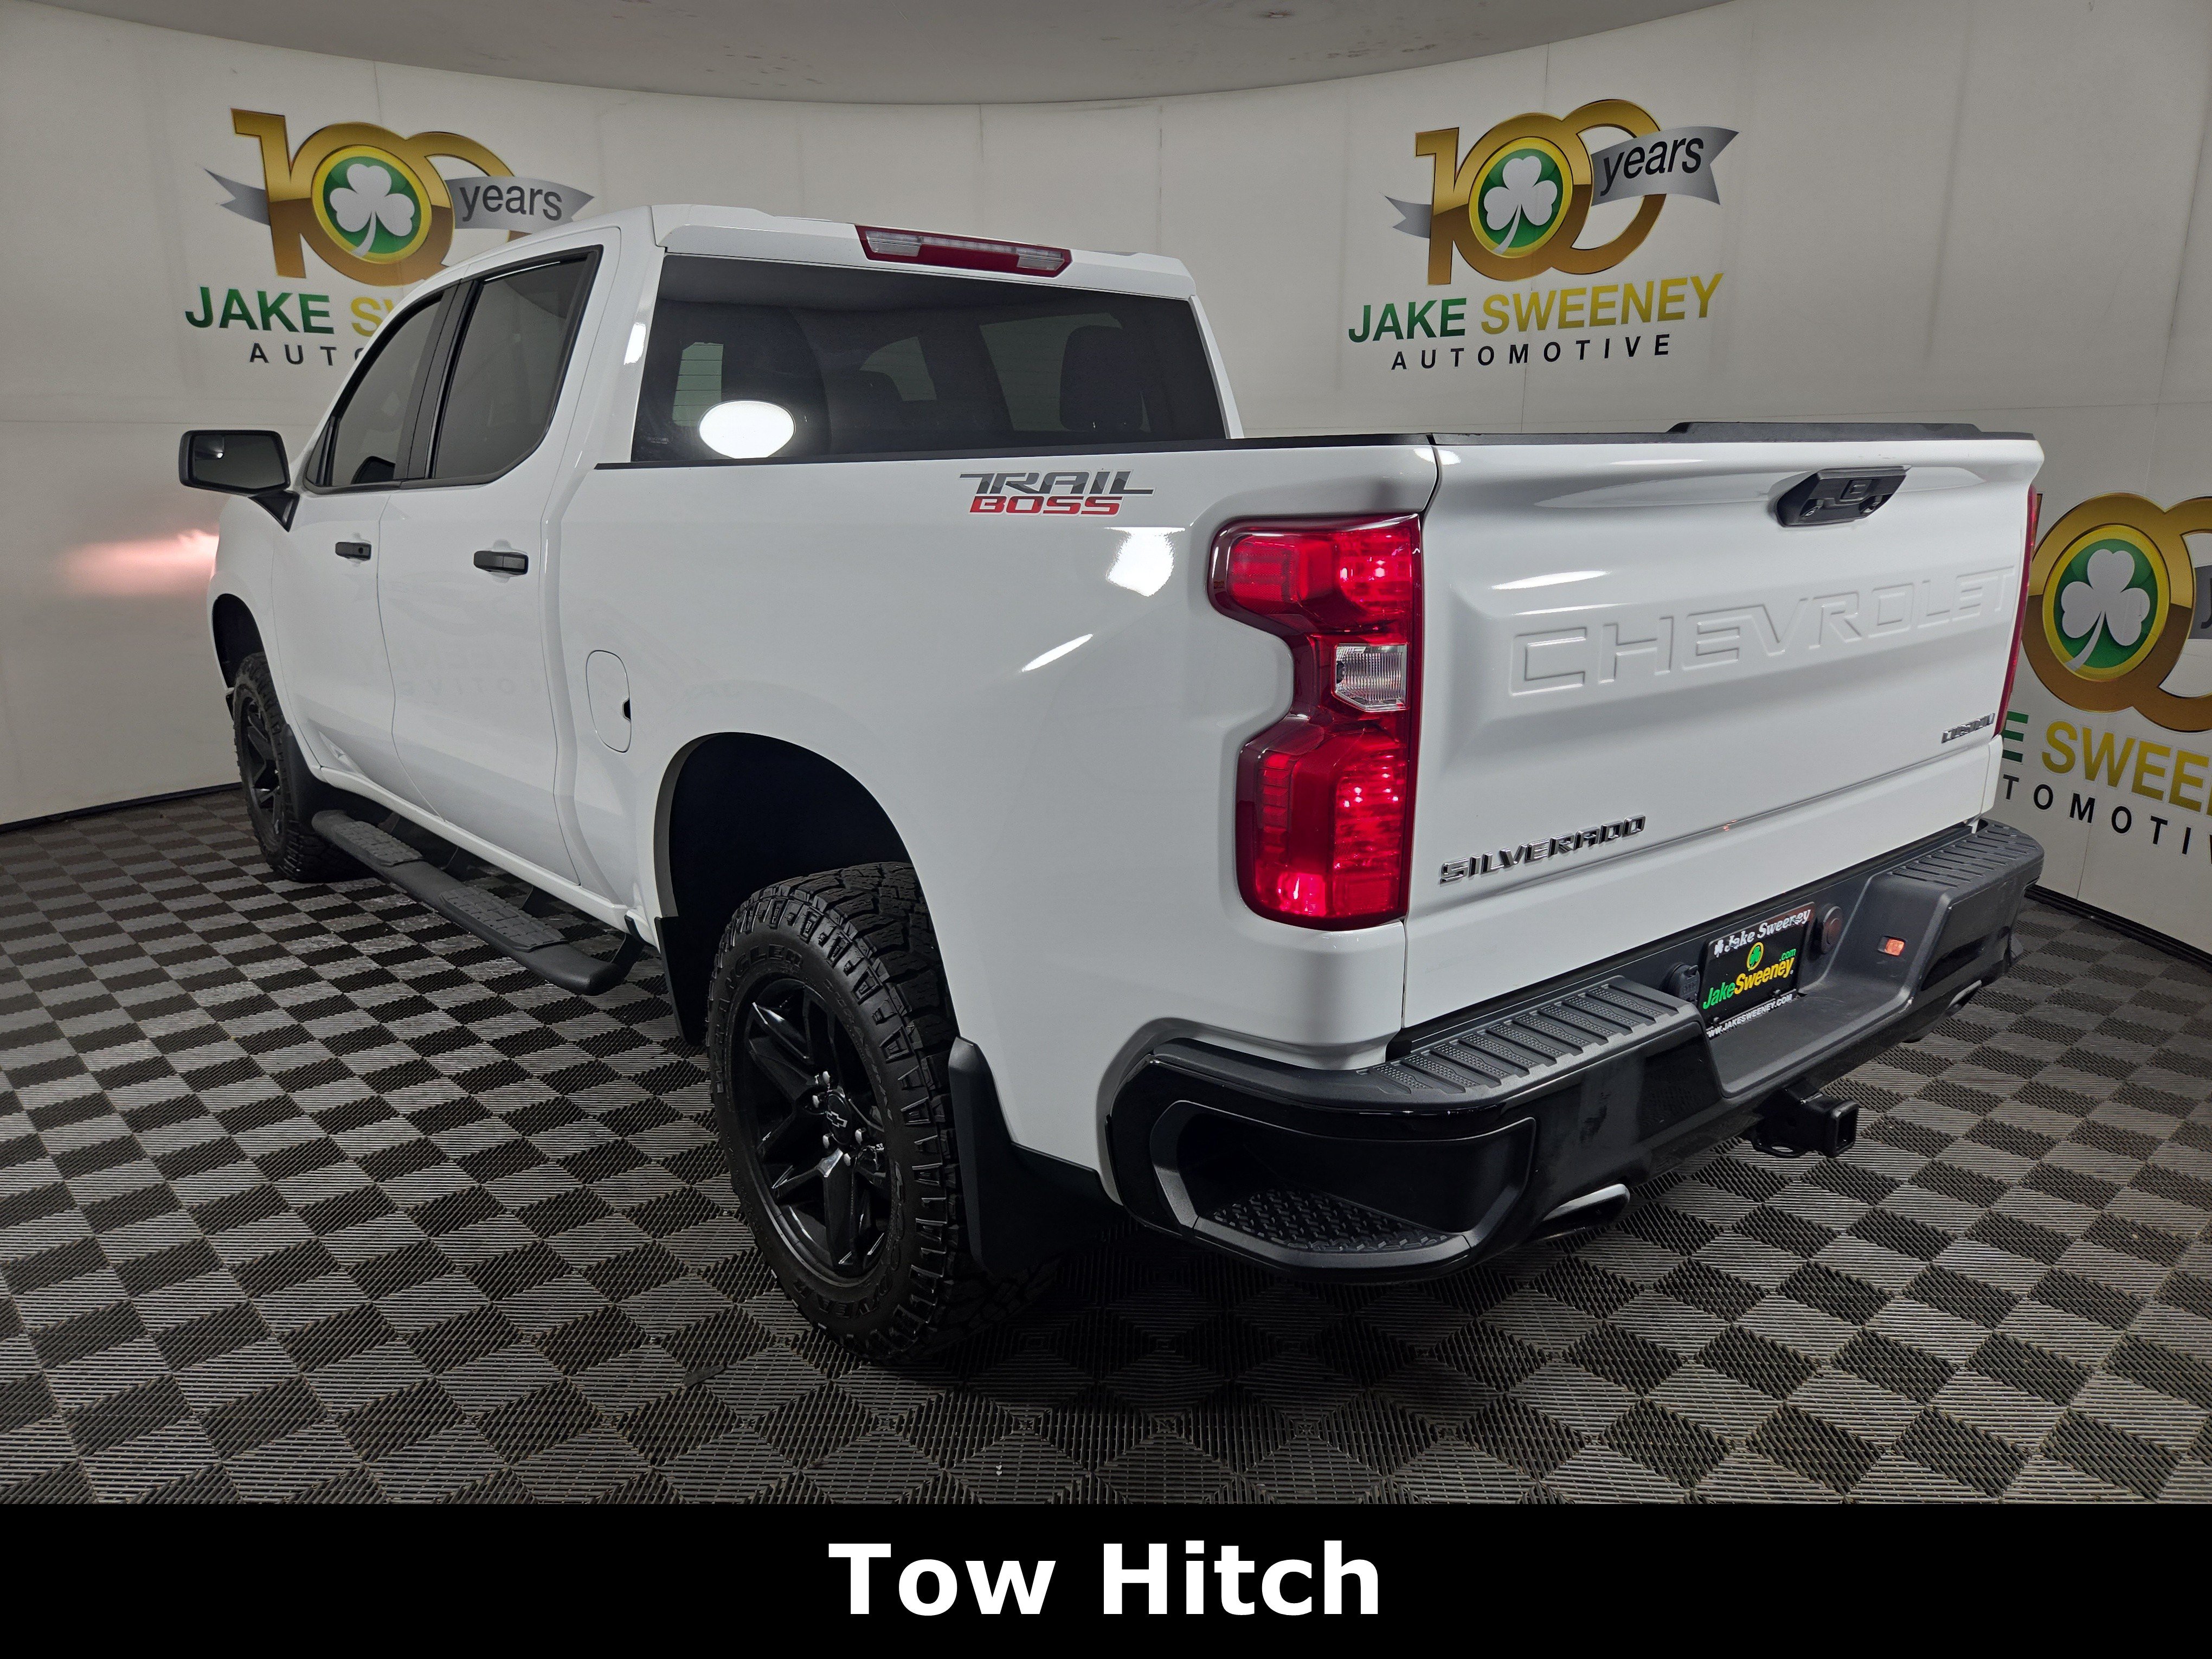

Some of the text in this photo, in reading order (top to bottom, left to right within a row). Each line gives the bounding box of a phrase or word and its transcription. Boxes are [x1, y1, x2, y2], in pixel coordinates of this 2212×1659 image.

[459, 185, 563, 222] years
[1415, 99, 1705, 286] 100 years
[185, 287, 335, 335] JAKE
[1348, 272, 1725, 343] JAKE SWEENEY
[1391, 333, 1670, 371] AUTOMOTIVE
[960, 471, 1154, 494] TRAIL
[969, 496, 1123, 515] BOSS
[1509, 565, 2015, 696] CHEVROLET
[1438, 815, 1647, 884] SILVERADO
[1725, 930, 1756, 953] Jake
[1779, 948, 1797, 961] .com
